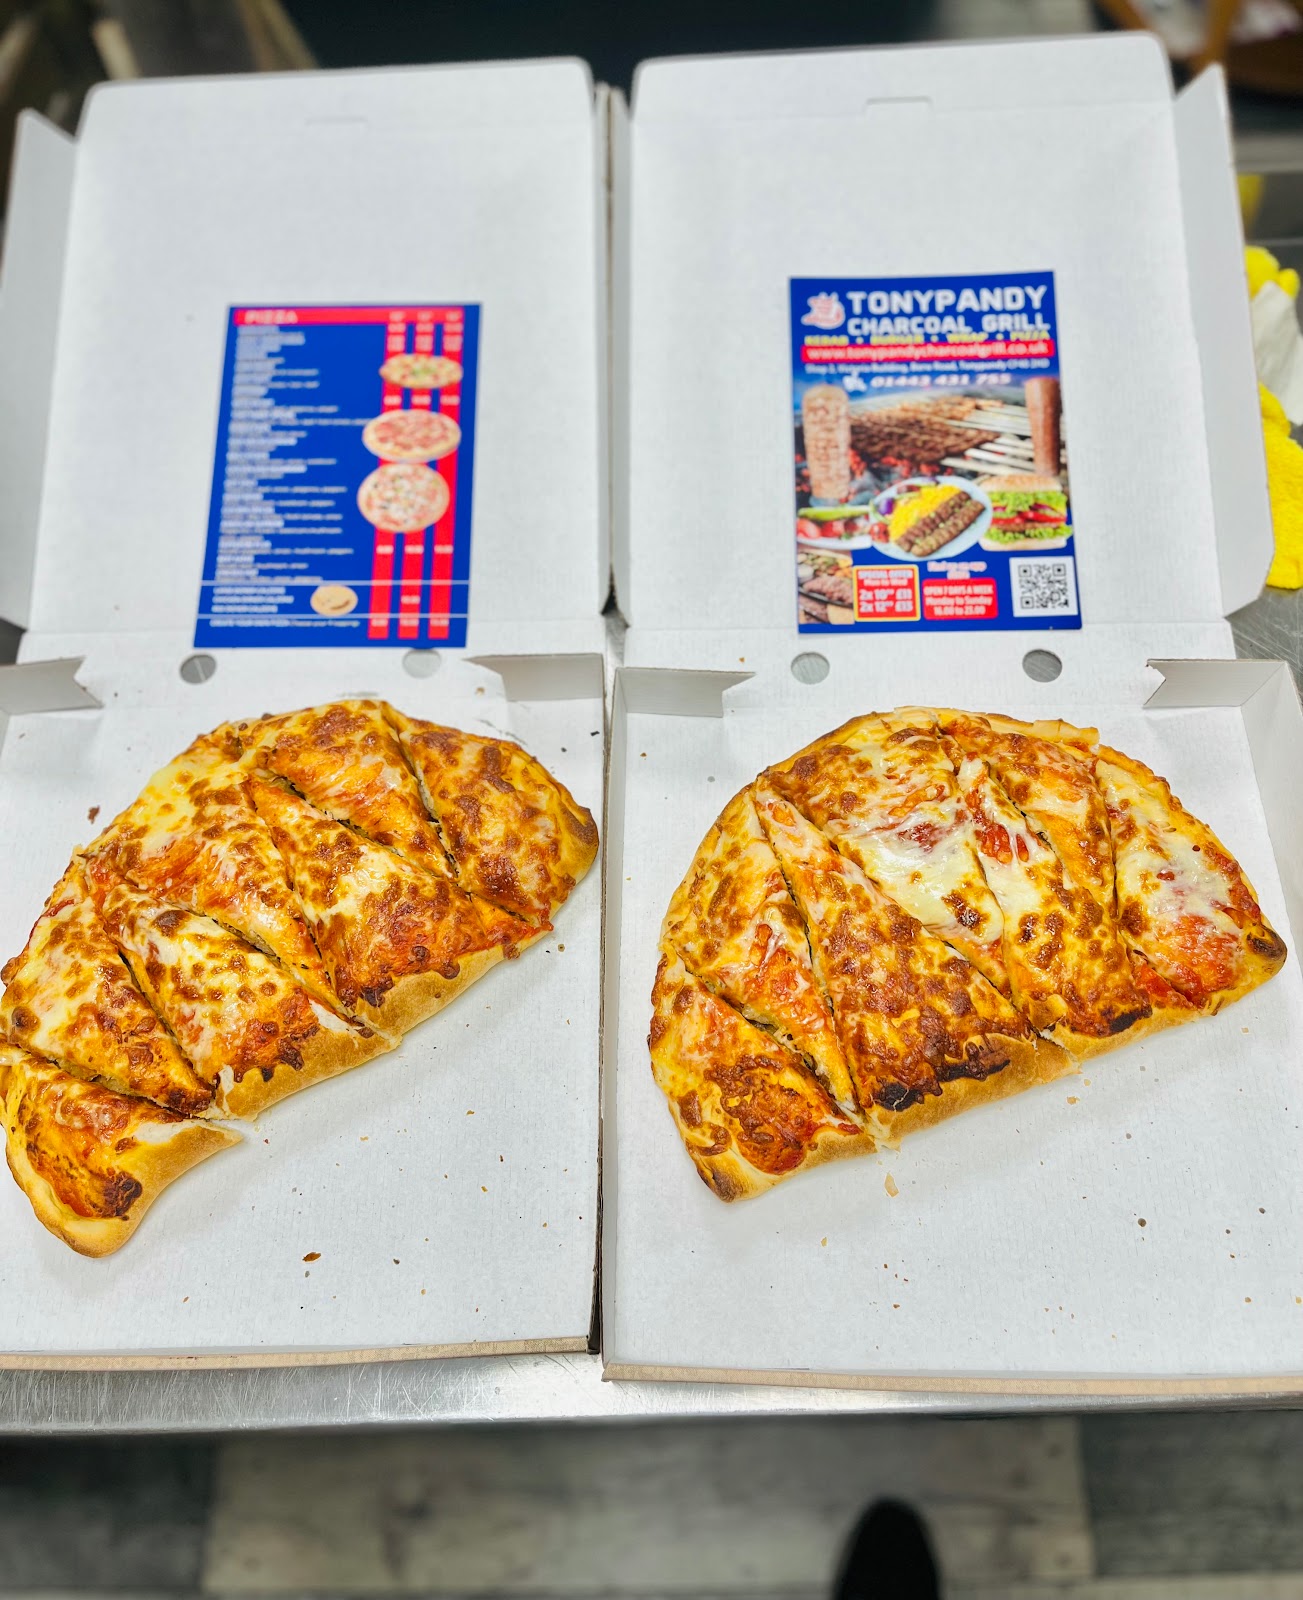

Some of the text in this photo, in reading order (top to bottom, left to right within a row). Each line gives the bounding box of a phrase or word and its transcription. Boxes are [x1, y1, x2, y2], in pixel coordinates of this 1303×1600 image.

[847, 285, 1047, 315] TONYPANDY
[847, 312, 1050, 336] CHARCOAL GRILL
